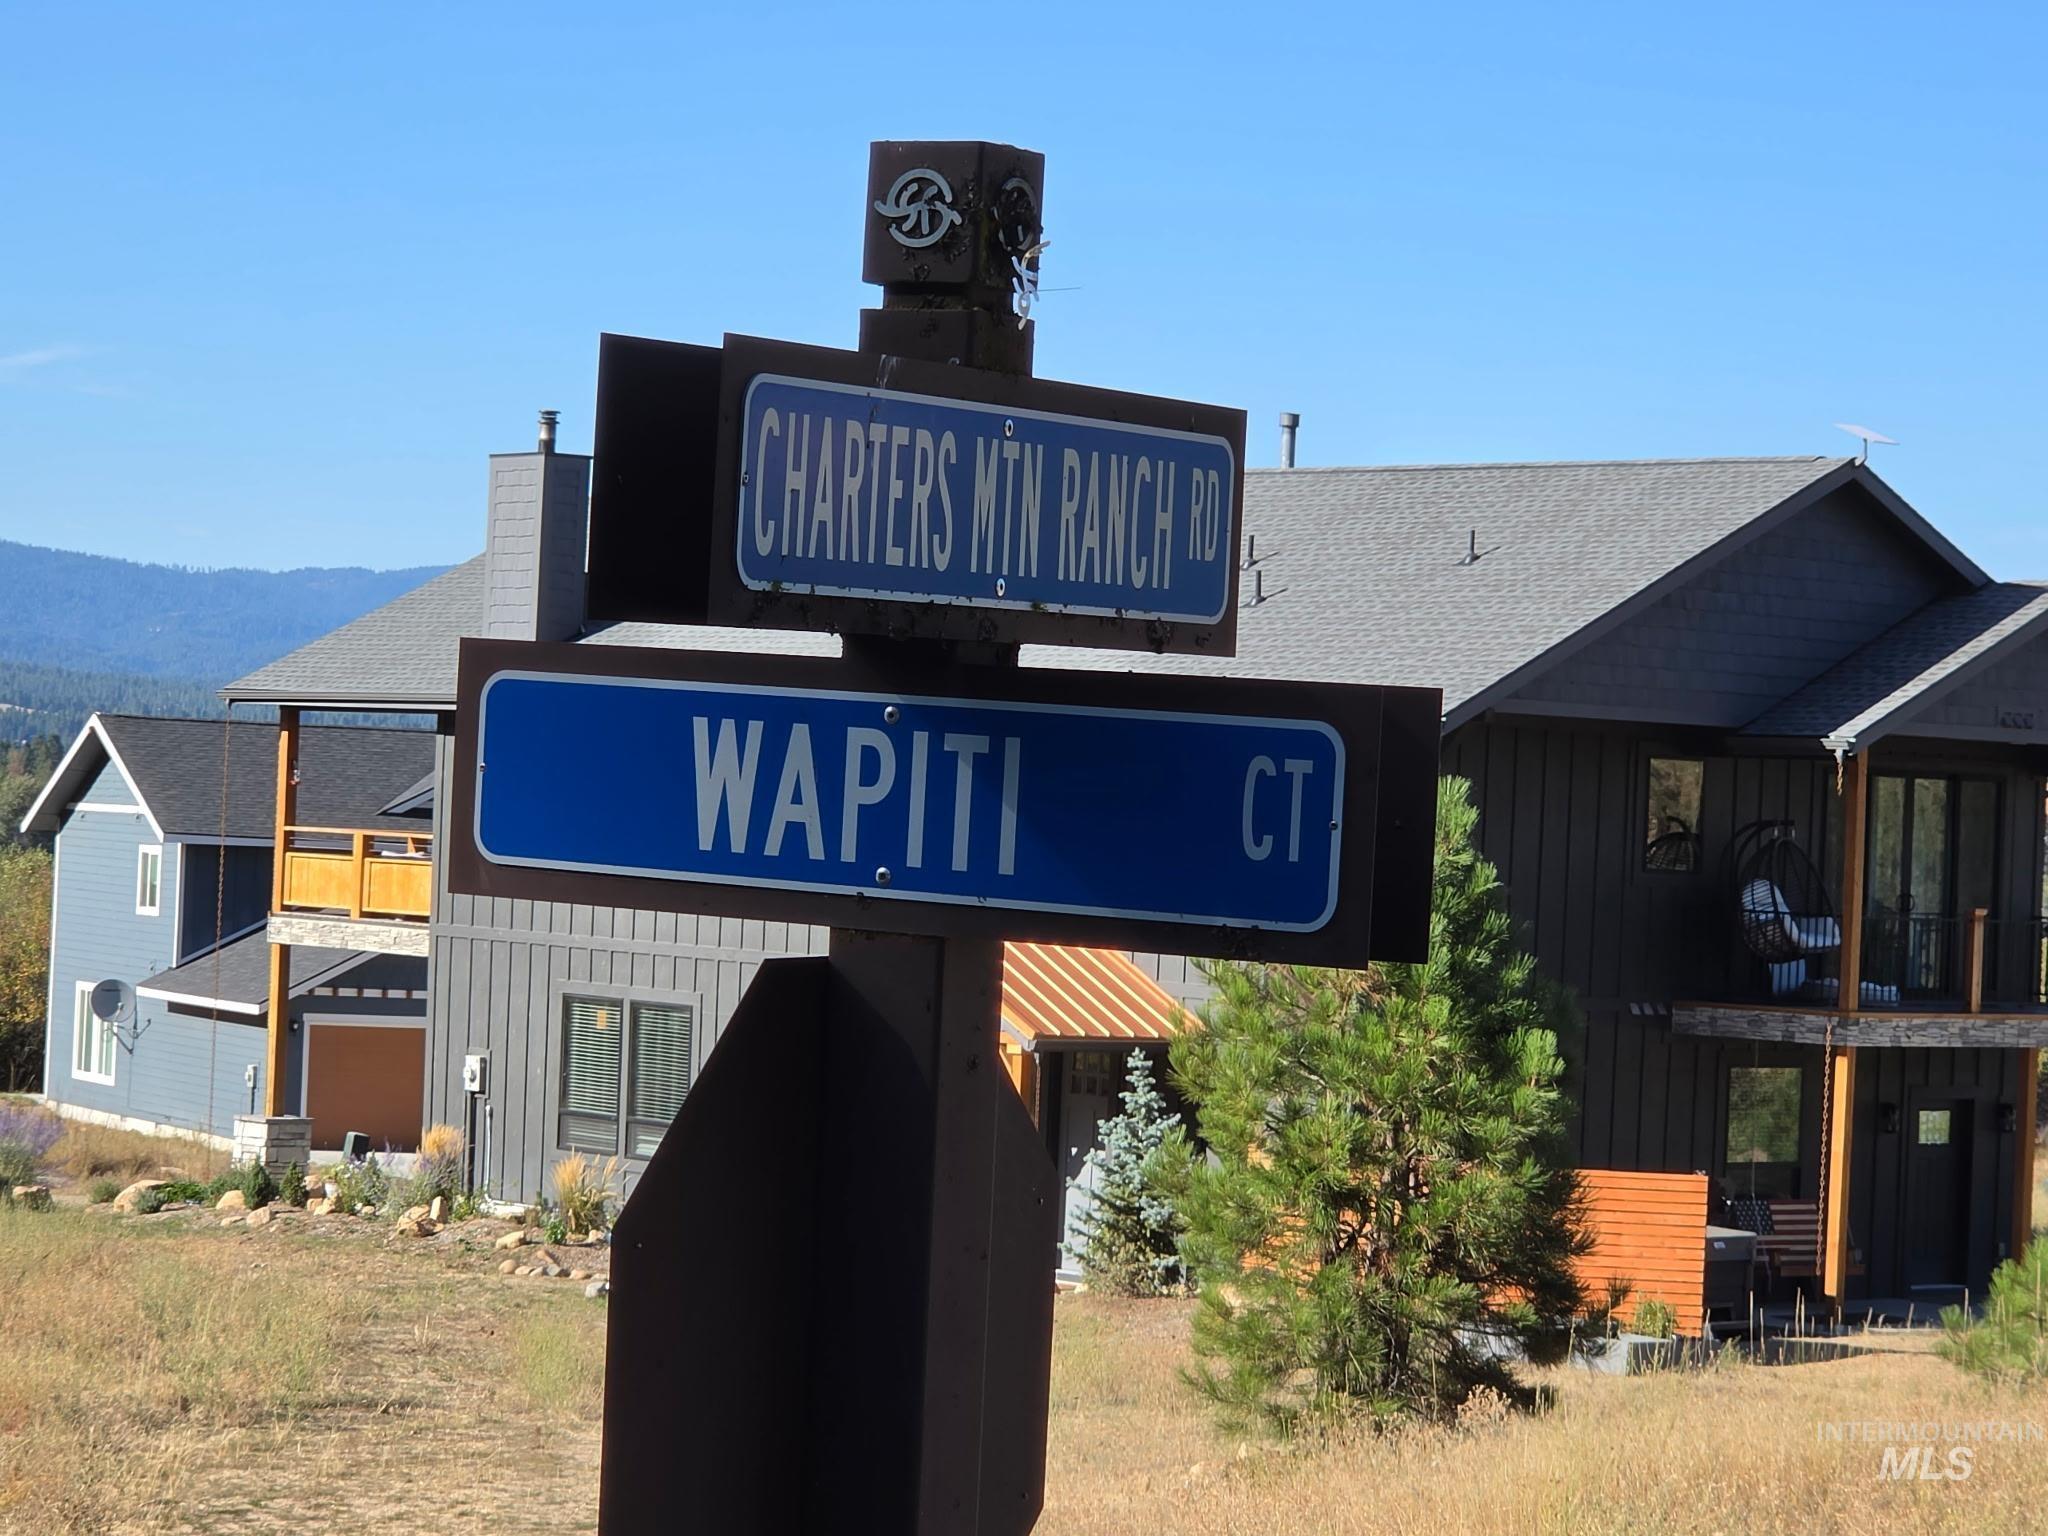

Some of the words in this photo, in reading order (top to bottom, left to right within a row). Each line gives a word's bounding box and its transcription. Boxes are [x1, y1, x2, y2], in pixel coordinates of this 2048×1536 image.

[754, 407, 956, 572] CHARTERS
[970, 436, 1043, 578] MTN
[1058, 448, 1175, 590] RANCH
[1189, 468, 1219, 562] RD
[693, 716, 1021, 875] WAPITI
[1242, 755, 1313, 862] CT
